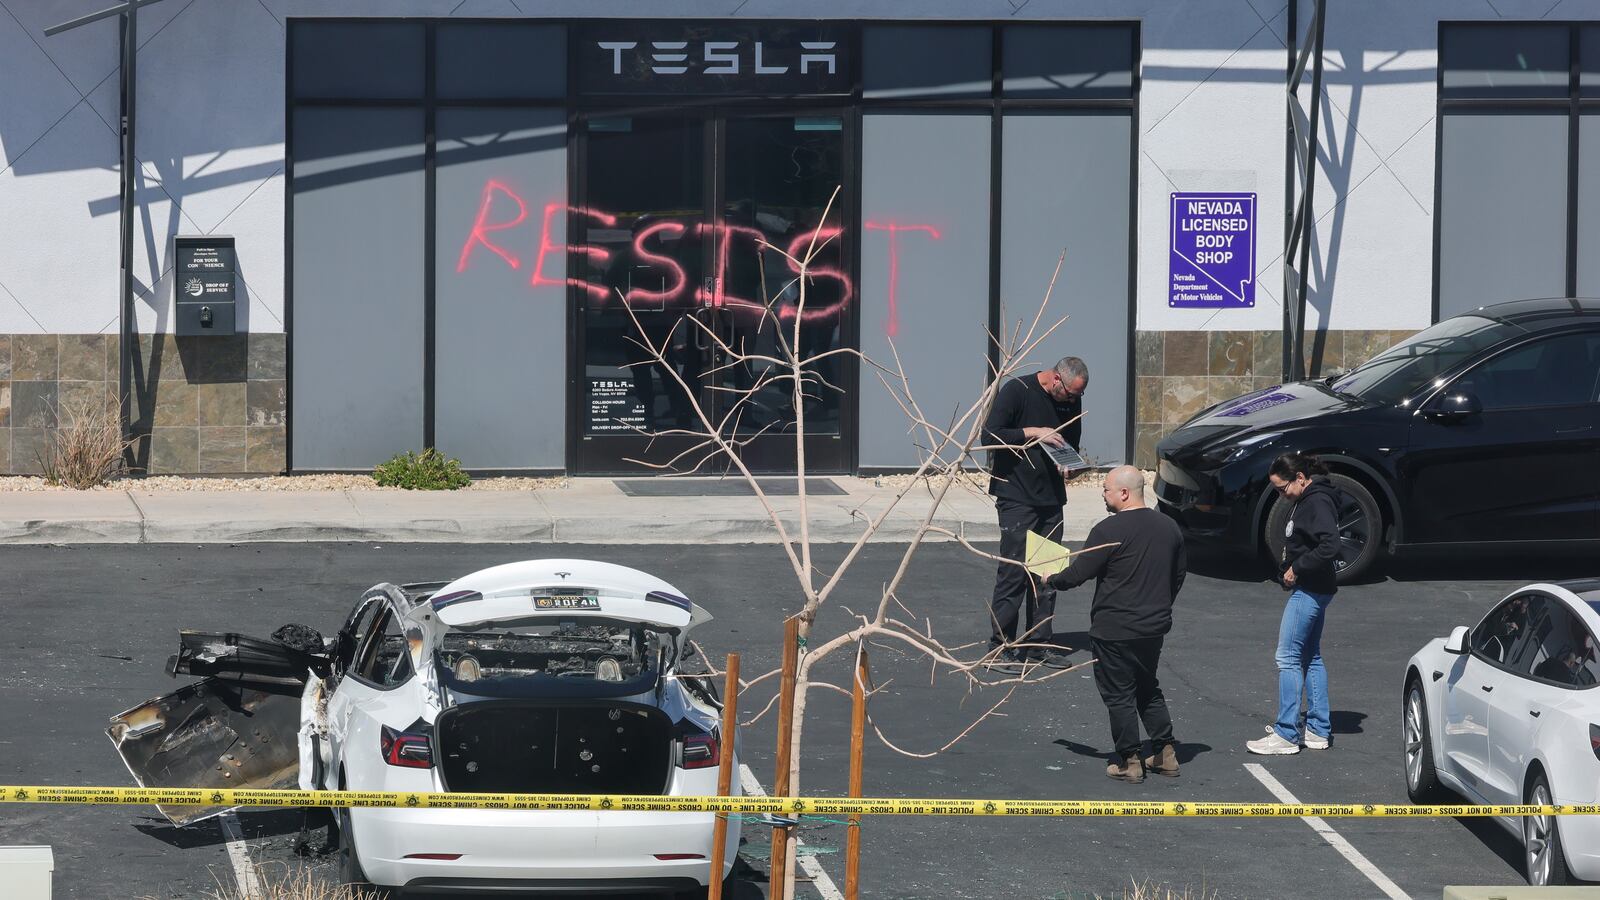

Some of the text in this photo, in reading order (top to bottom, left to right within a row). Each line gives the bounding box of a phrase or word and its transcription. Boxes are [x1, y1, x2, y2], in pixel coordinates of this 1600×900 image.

[597, 41, 837, 74] TESLA
[1188, 202, 1243, 214] NEVADA
[1182, 219, 1248, 231] LICENSED
[1196, 235, 1234, 248] BODY
[457, 180, 942, 336] RESIST
[1196, 252, 1233, 264] SHOP
[1173, 284, 1208, 292] Department
